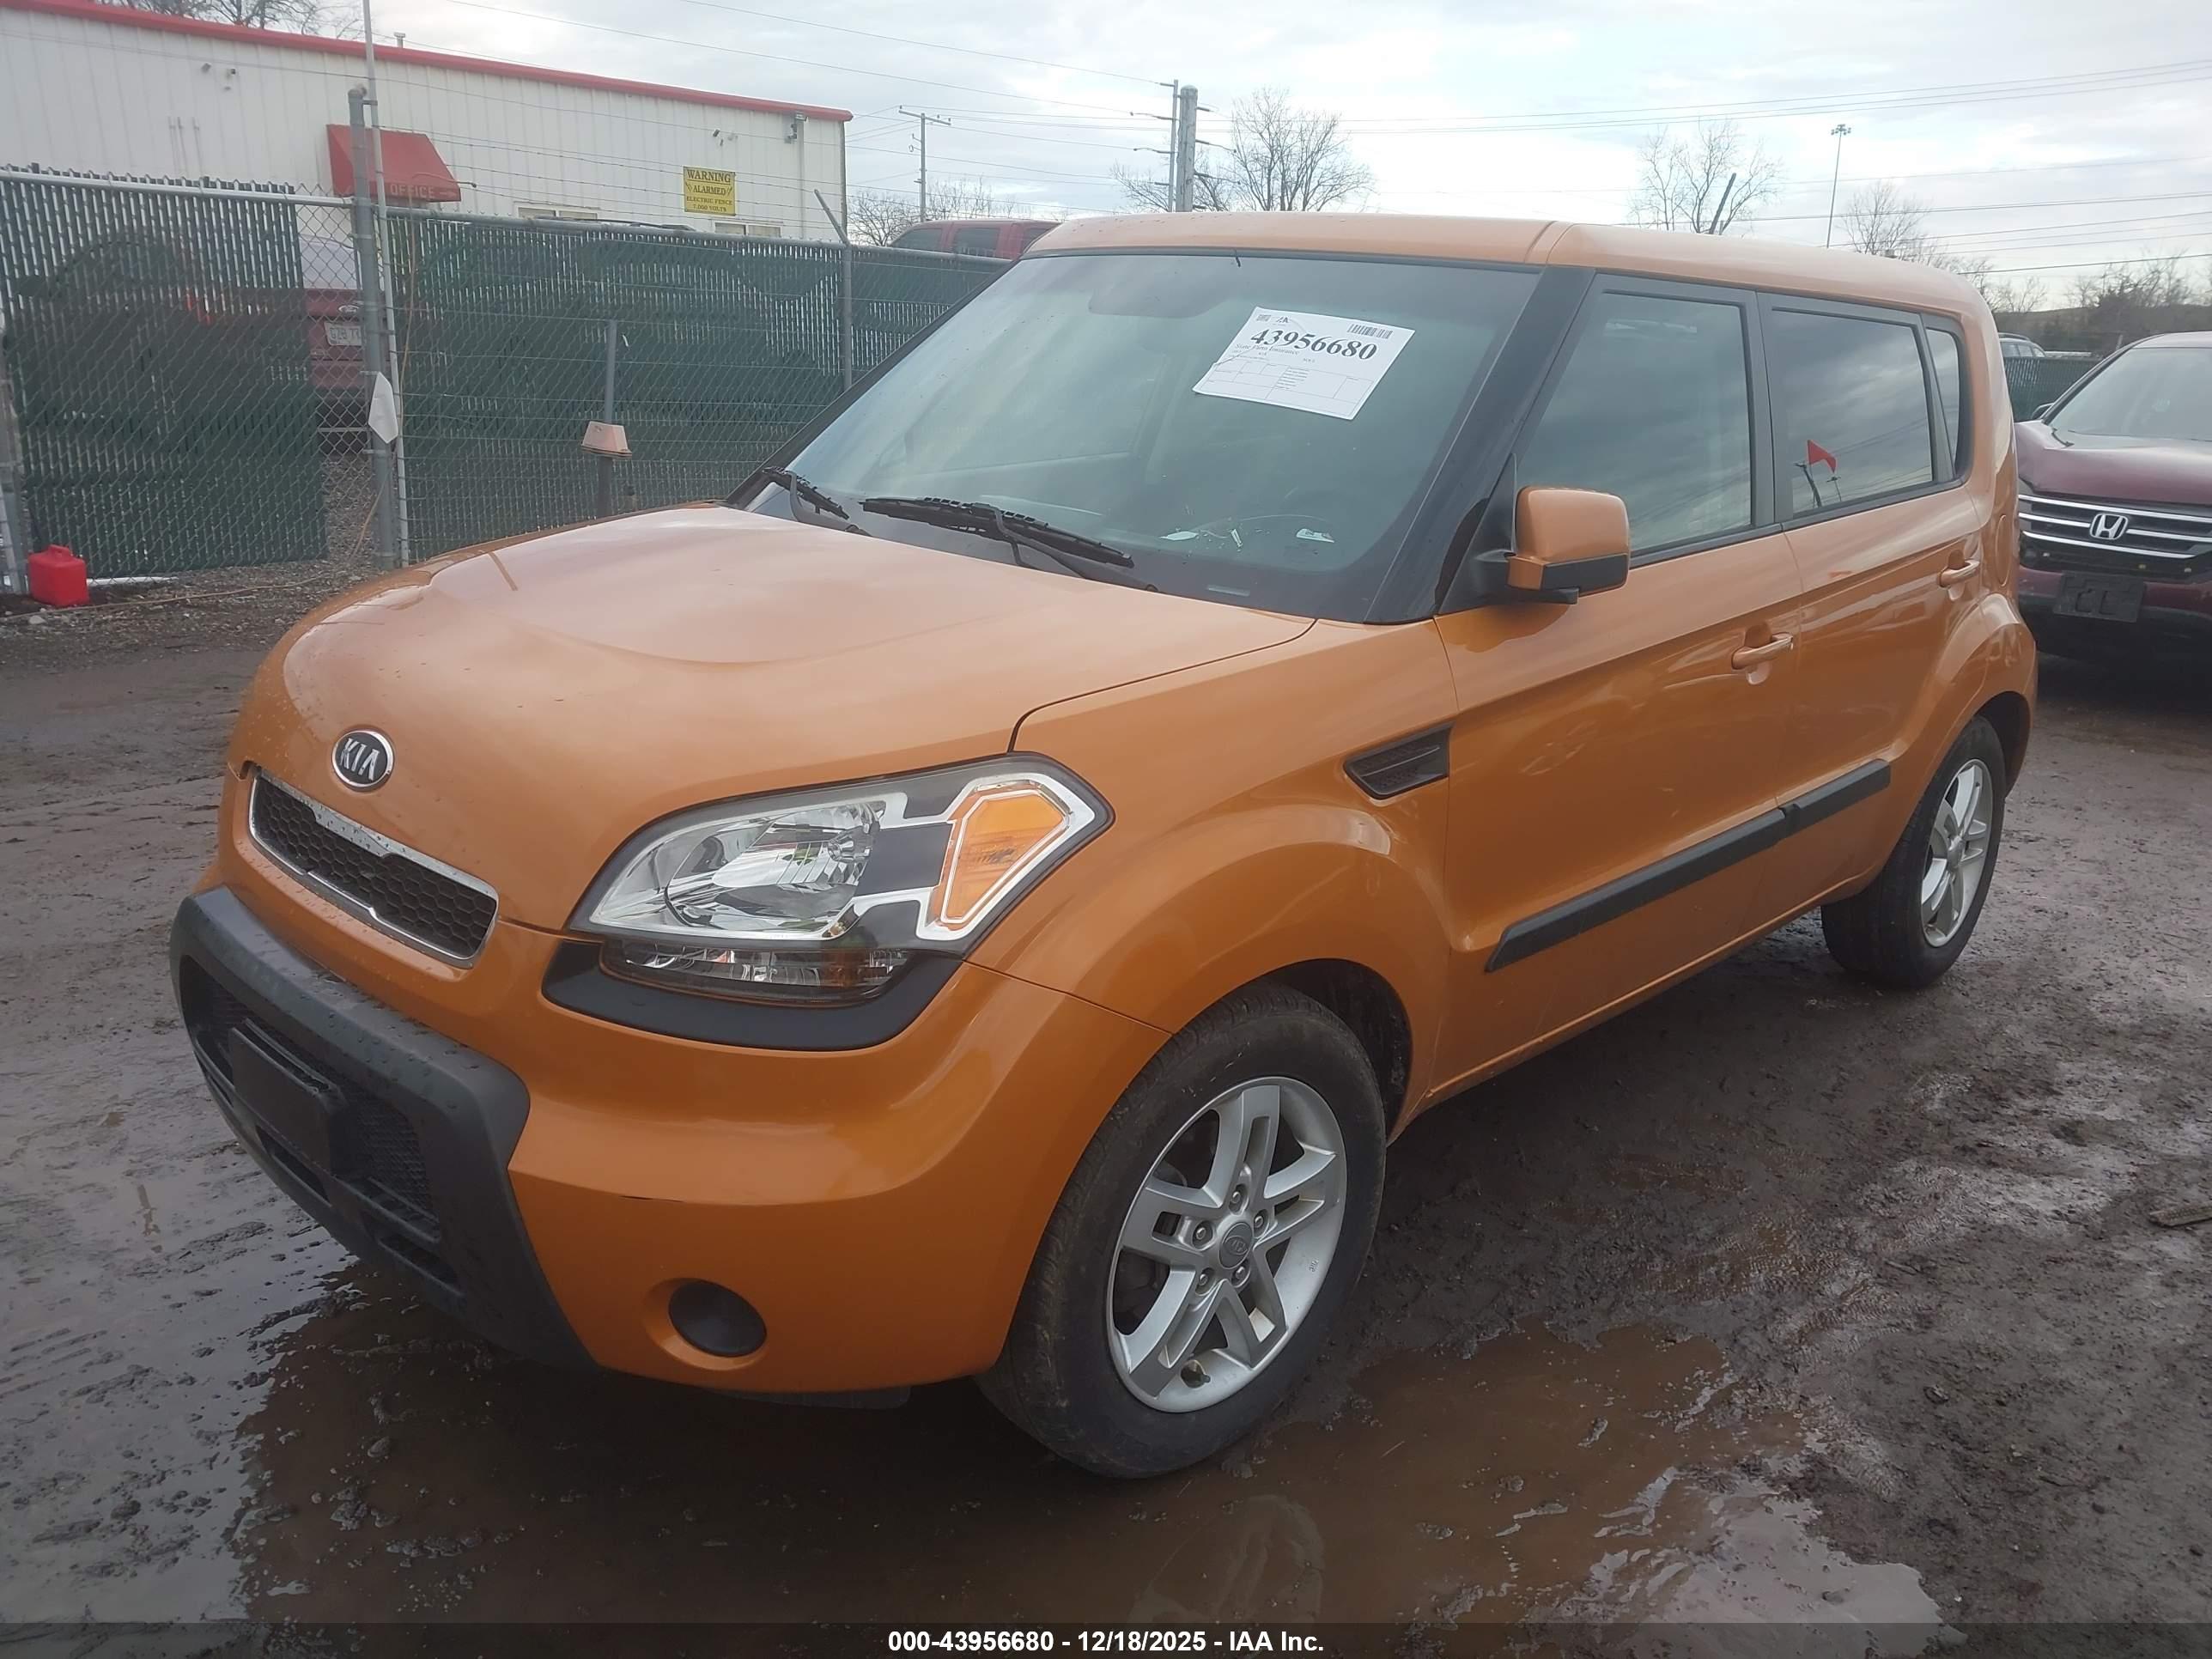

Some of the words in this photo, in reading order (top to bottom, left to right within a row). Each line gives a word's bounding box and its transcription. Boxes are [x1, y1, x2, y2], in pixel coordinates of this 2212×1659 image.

[687, 169, 731, 183] WARNING
[390, 183, 436, 199] OFFICE
[693, 185, 726, 196] ALARMED
[686, 196, 714, 204] ELECTRIC
[1250, 329, 1377, 360] 43956680
[339, 738, 380, 781] KIA
